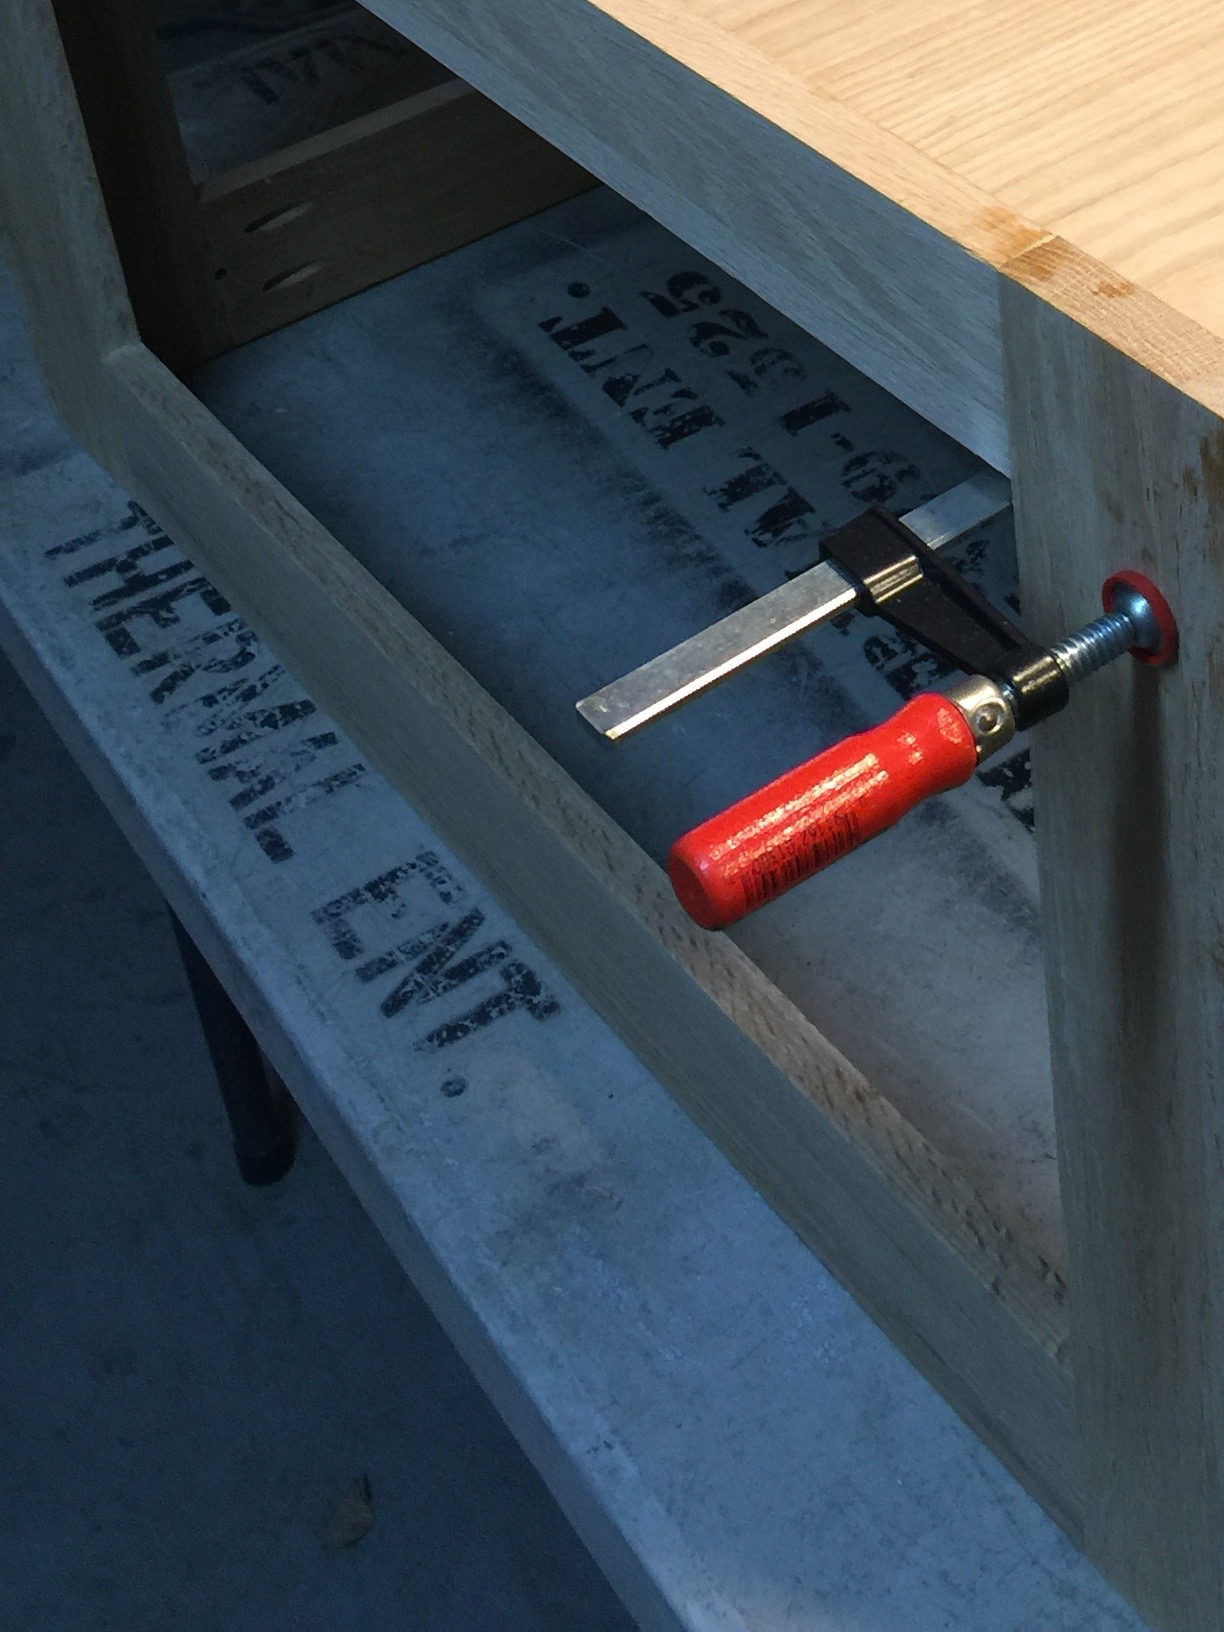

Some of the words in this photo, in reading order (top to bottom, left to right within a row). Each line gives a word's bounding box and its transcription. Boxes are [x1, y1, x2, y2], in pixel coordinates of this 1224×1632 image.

[538, 281, 726, 451] ENT.
[45, 499, 366, 865] THERMAL
[310, 850, 562, 1099] ENT.
